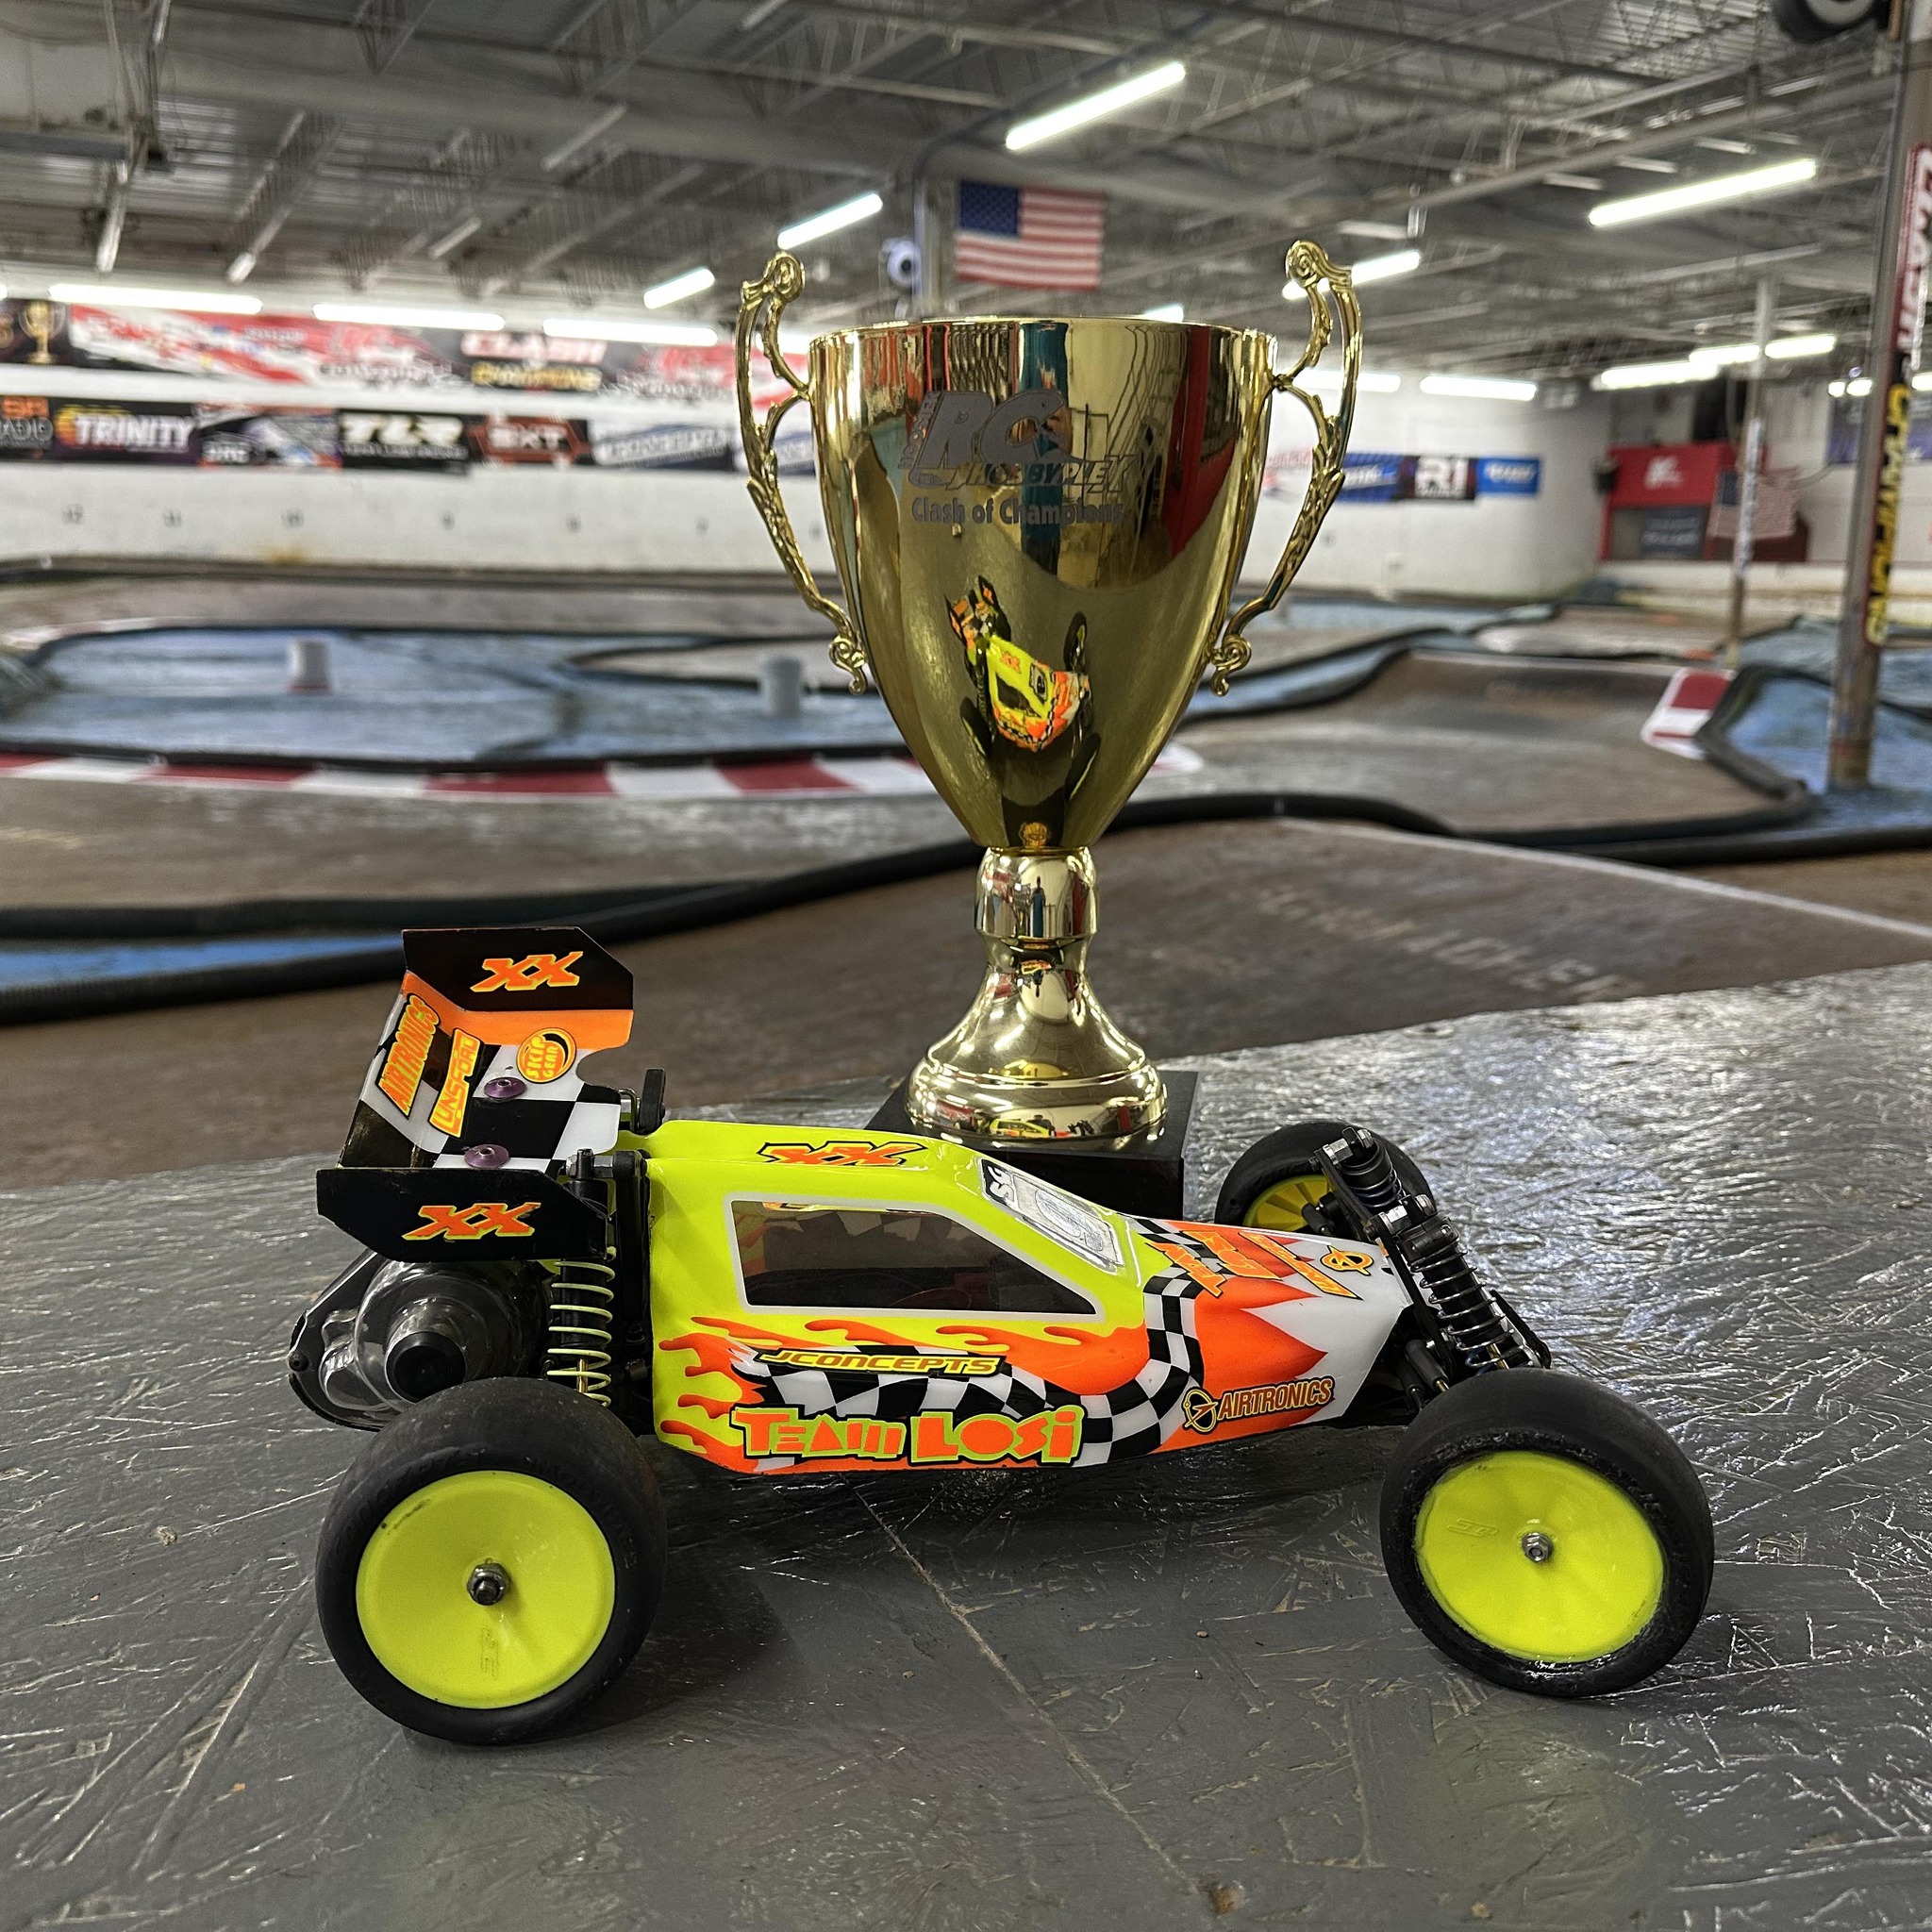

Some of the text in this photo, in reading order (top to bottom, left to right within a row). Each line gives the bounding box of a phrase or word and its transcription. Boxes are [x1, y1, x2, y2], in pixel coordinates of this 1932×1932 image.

[75, 413, 195, 449] TRINITY
[342, 413, 463, 446] TLR
[915, 390, 1070, 469] RC
[911, 497, 1124, 527] Clash of Champions
[470, 951, 583, 991] XX
[377, 994, 441, 1116] AIRTRONICS
[525, 1037, 546, 1078] SKIP
[542, 1046, 558, 1078] GEAR
[758, 1141, 927, 1166] XX
[402, 1202, 541, 1241] XX
[758, 1350, 1000, 1375] JCONCEPTS
[1217, 1379, 1333, 1421] AIRTRONICS
[732, 1407, 906, 1458] TEAM
